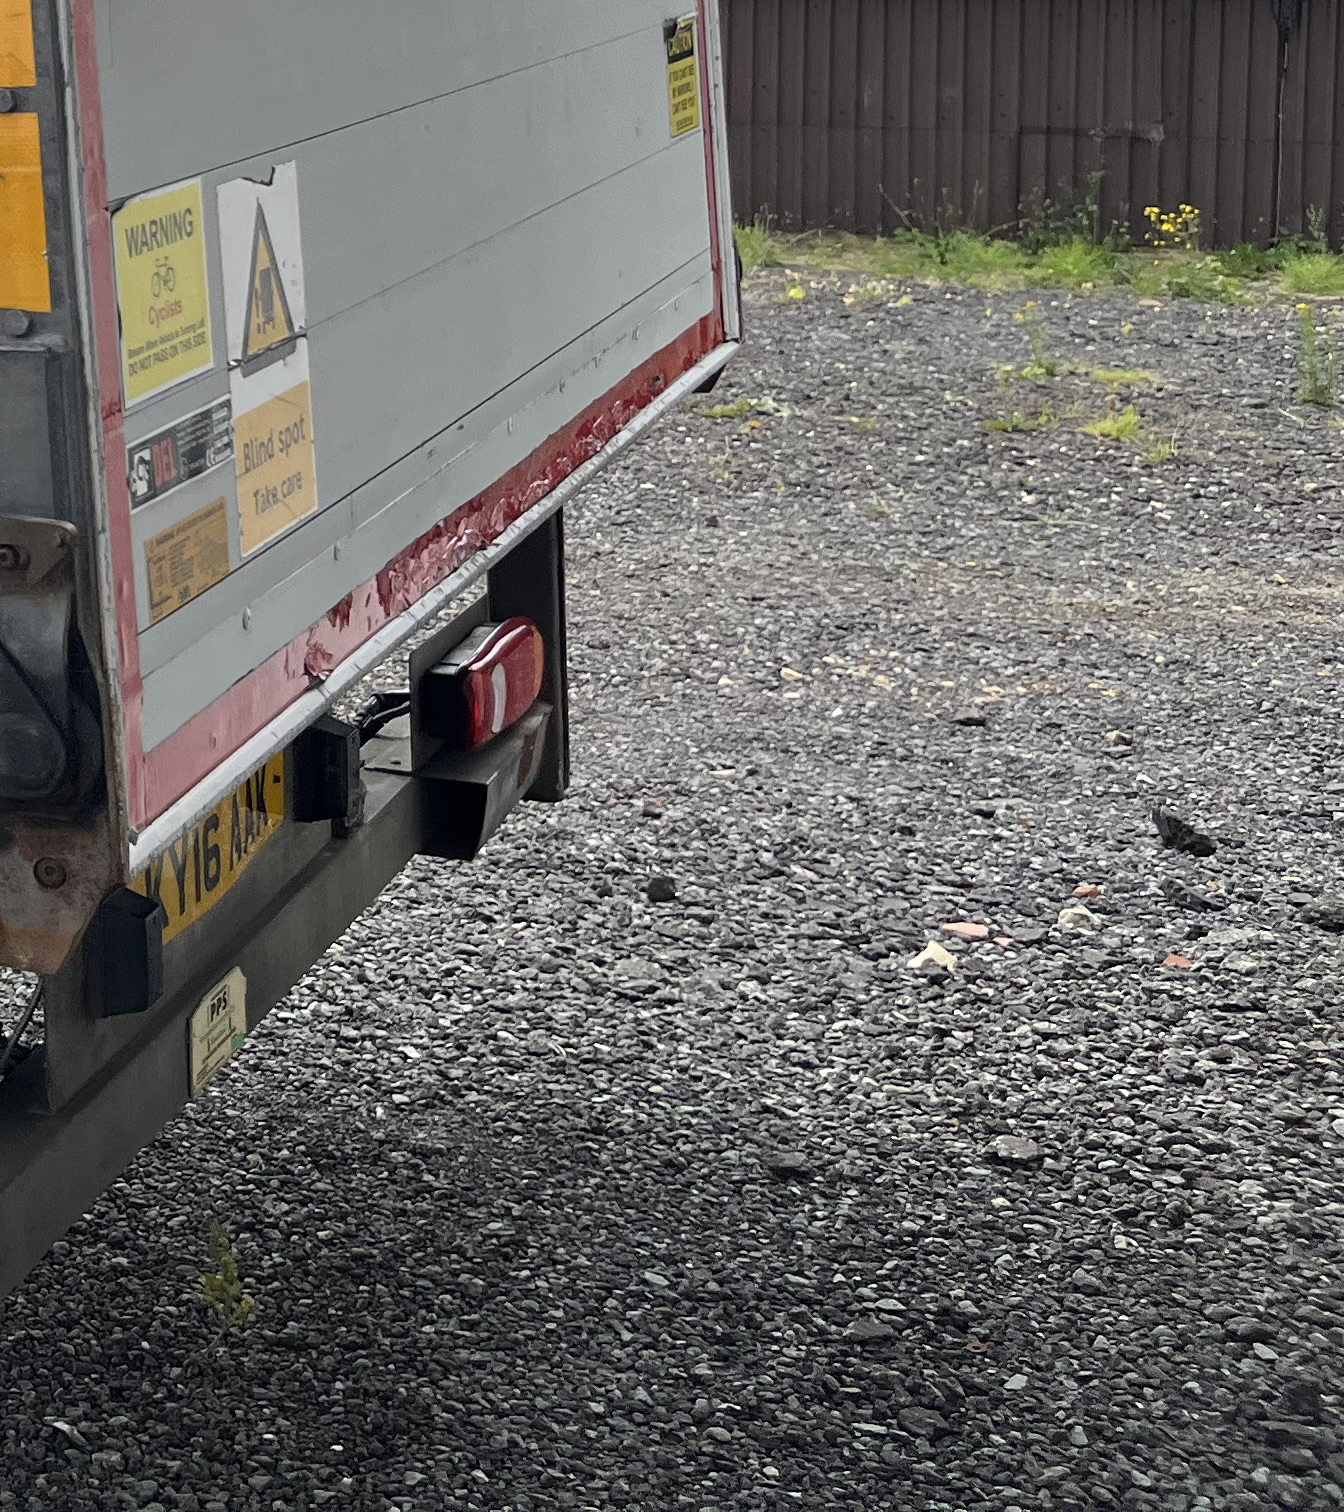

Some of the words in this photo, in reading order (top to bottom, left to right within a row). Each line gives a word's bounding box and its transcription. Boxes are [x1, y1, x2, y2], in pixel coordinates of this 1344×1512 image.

[124, 207, 194, 258] WARNING
[148, 299, 183, 328] Cyclists
[128, 361, 138, 377] DO
[139, 354, 152, 371] NOT
[153, 347, 169, 364] PASS
[169, 343, 179, 358] ON
[179, 337, 192, 352] THIS
[193, 331, 206, 347] SIDE
[243, 428, 275, 474] Blind
[278, 413, 306, 458] spot
[253, 484, 279, 516] Take
[281, 471, 303, 499] care
[211, 990, 227, 1023] PPS
